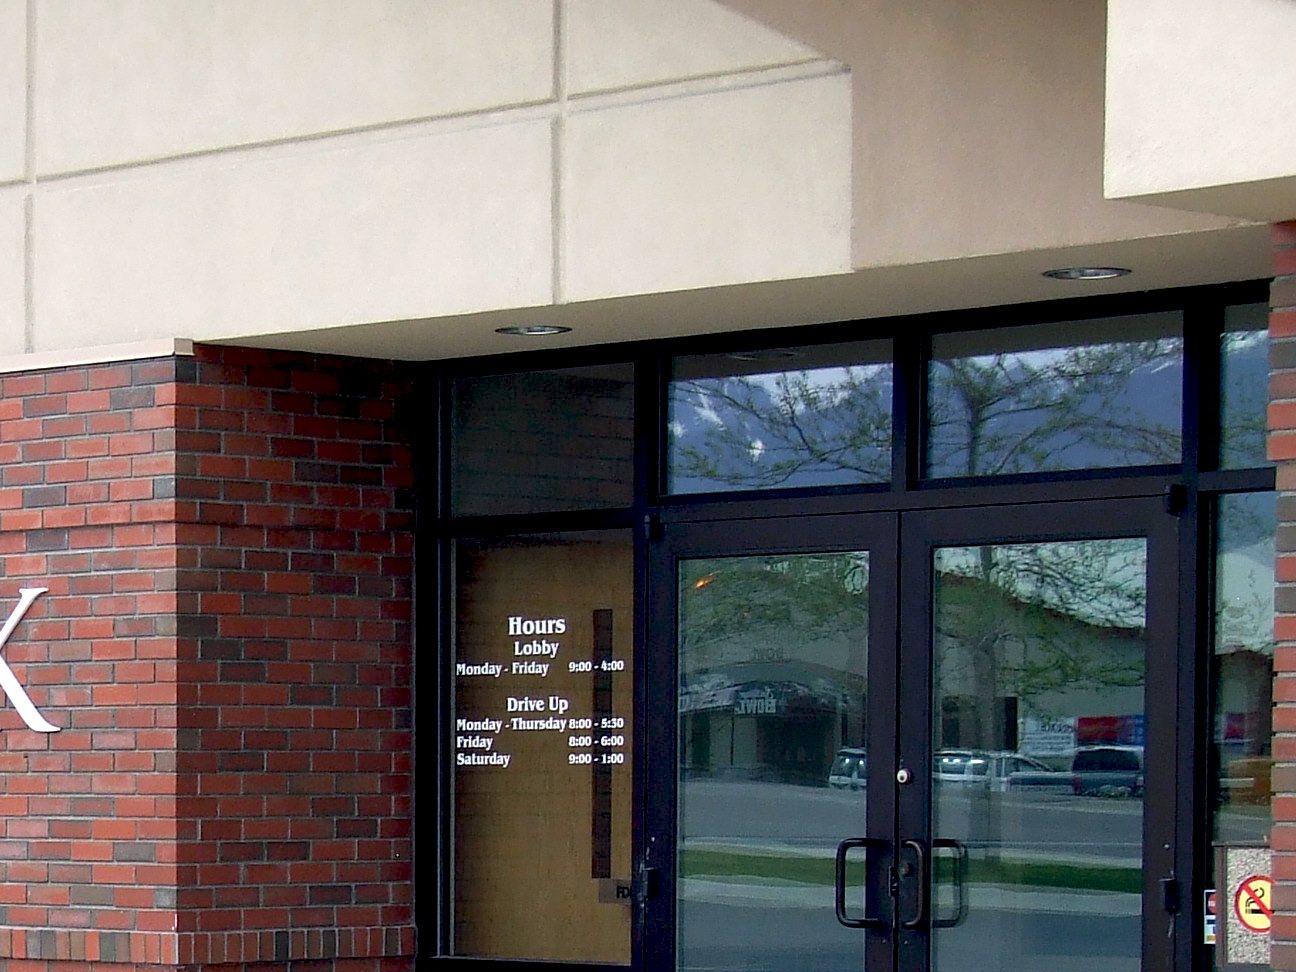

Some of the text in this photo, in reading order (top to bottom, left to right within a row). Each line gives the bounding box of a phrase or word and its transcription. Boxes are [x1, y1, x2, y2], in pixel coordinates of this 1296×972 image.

[508, 616, 566, 635] Hours
[514, 640, 559, 658] Lobby
[456, 662, 502, 677] Monday
[512, 661, 549, 677] Friday
[568, 661, 592, 672] 9:00
[601, 660, 624, 671] 4:00
[507, 696, 569, 714] Drive Up
[456, 718, 503, 733] Monday
[511, 717, 567, 732] Thursday
[568, 719, 592, 729] 8:00
[456, 736, 494, 750] Friday
[568, 736, 592, 747] 8:00
[600, 735, 624, 746] 6:00
[456, 753, 511, 768] Saturday
[568, 753, 592, 764] 9:00
[601, 753, 624, 764] 1:00
